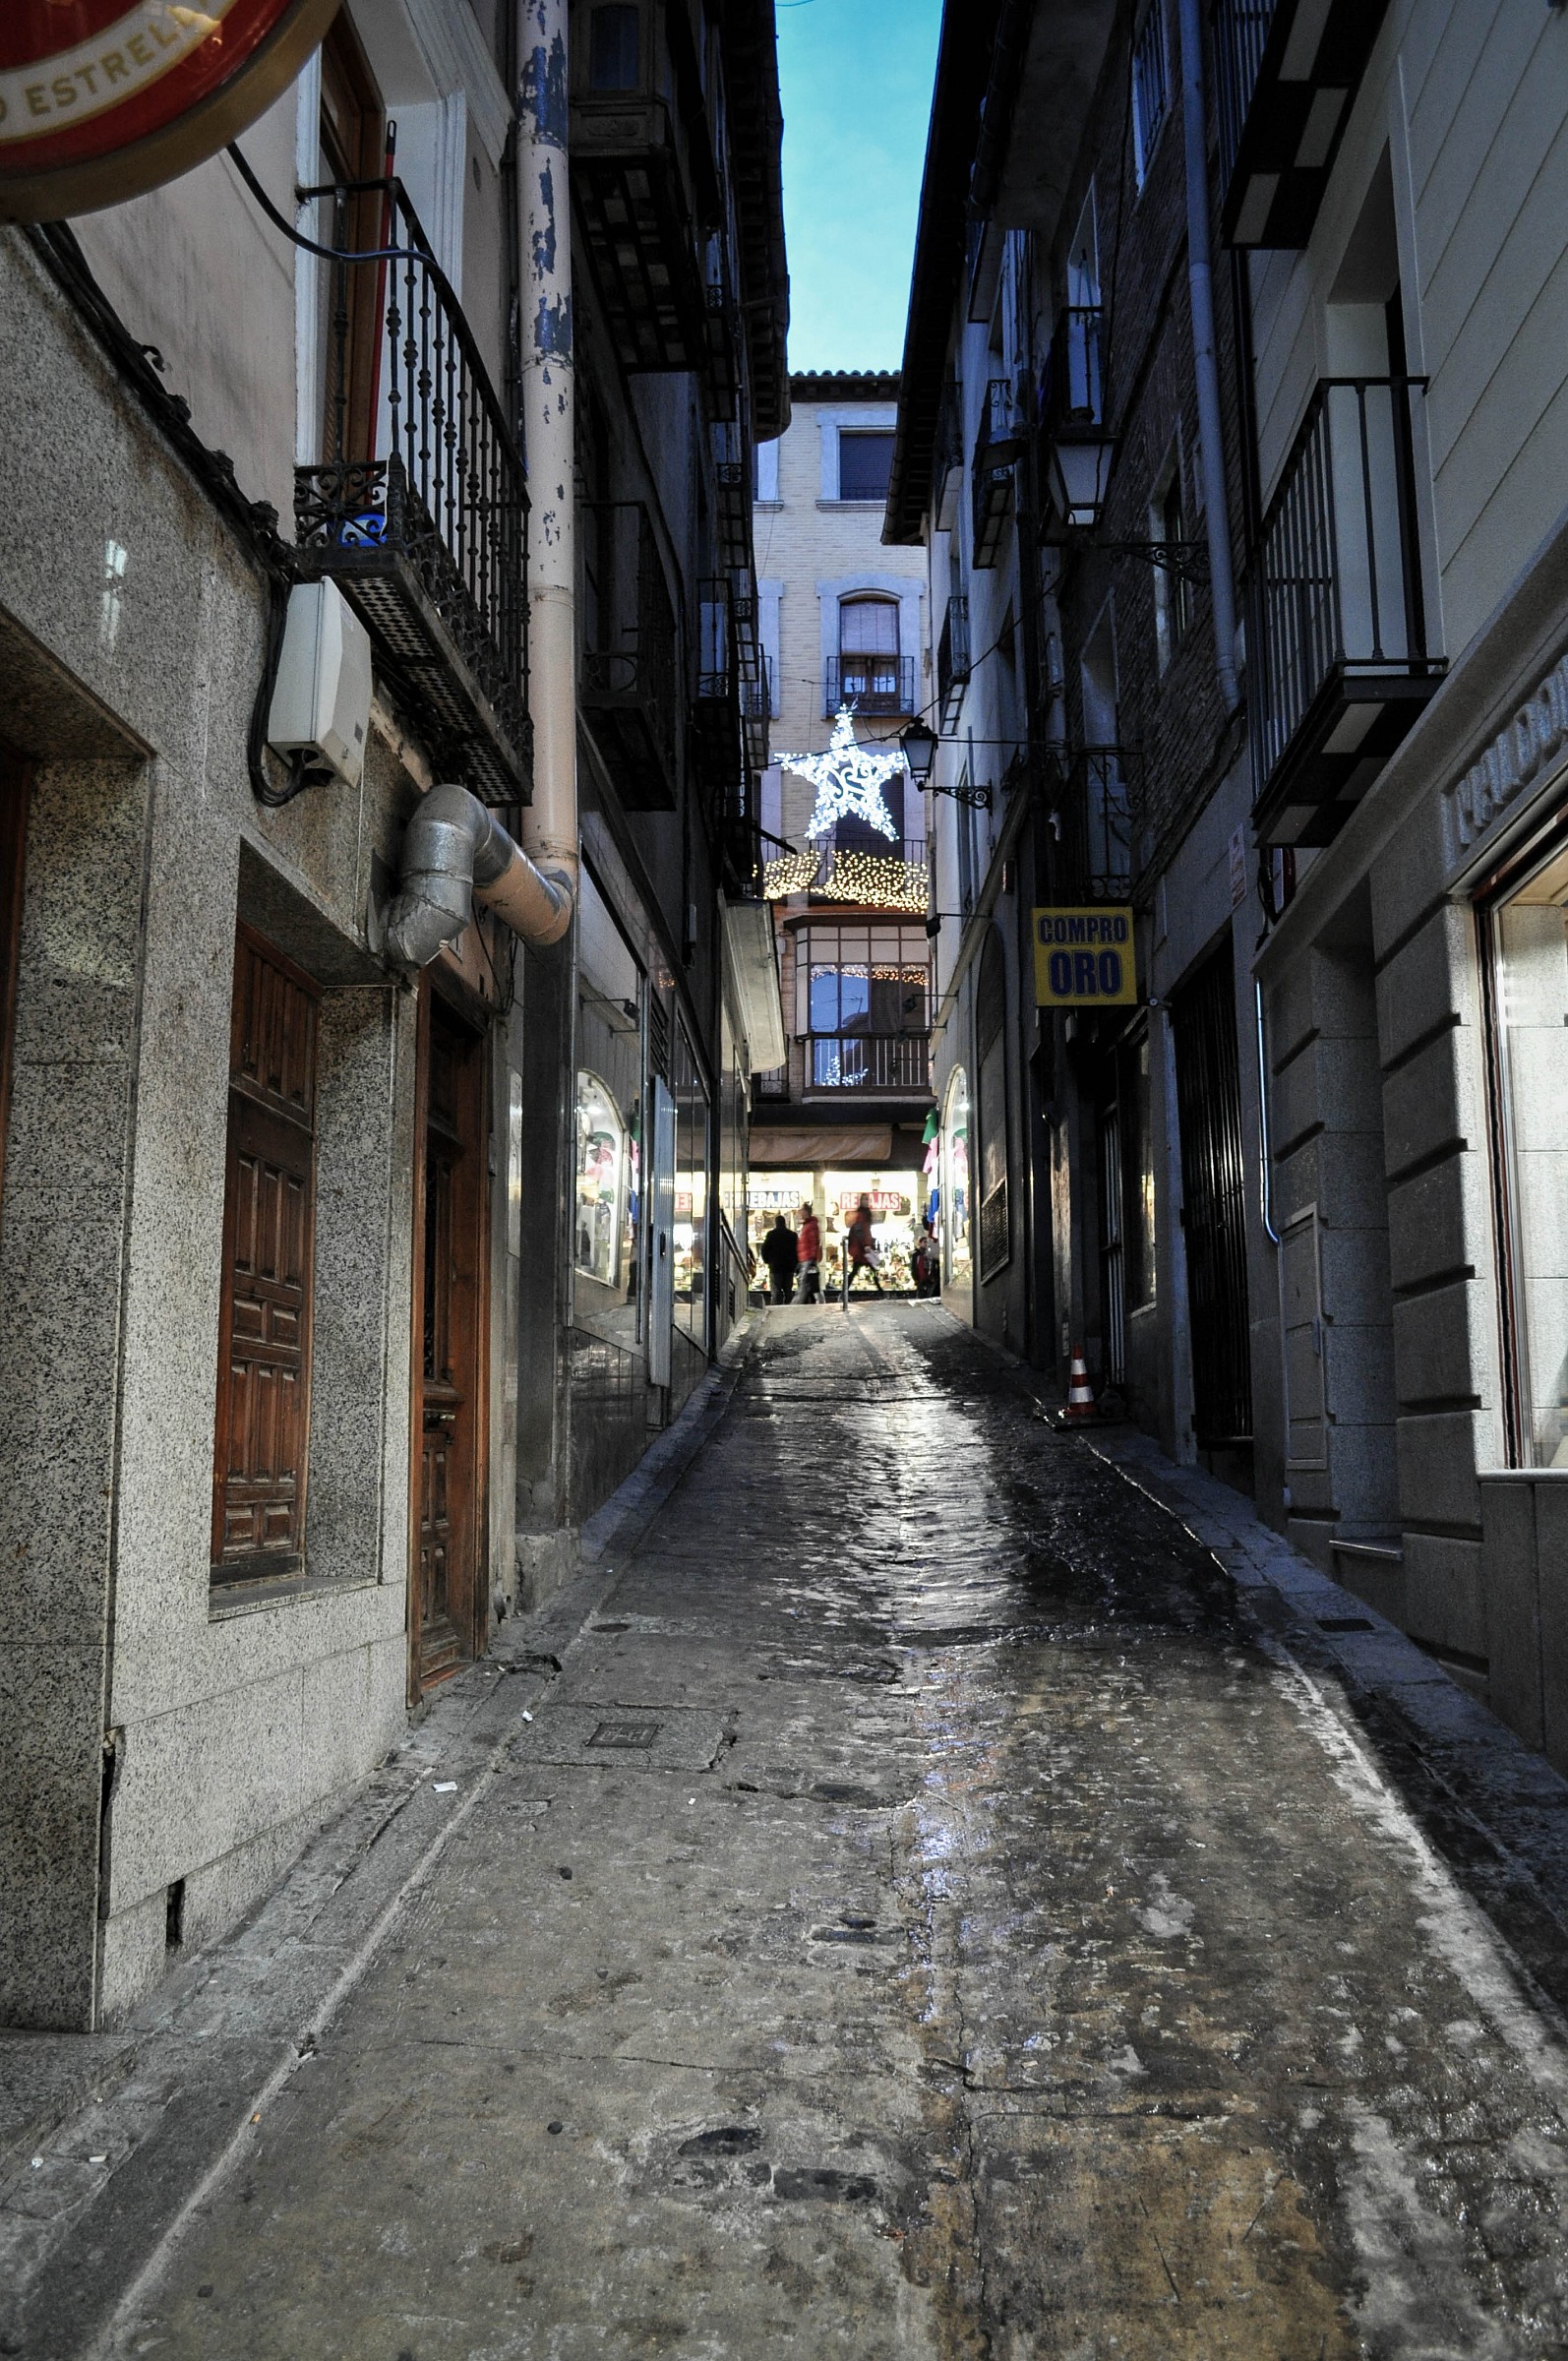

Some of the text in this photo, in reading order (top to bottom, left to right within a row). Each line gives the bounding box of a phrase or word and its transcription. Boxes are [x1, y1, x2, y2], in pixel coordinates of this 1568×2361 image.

[1038, 914, 1128, 945] COMPRO
[1049, 949, 1122, 998] ORO
[747, 1191, 799, 1208] EBAJAS
[842, 1192, 899, 1209] REAJAS
